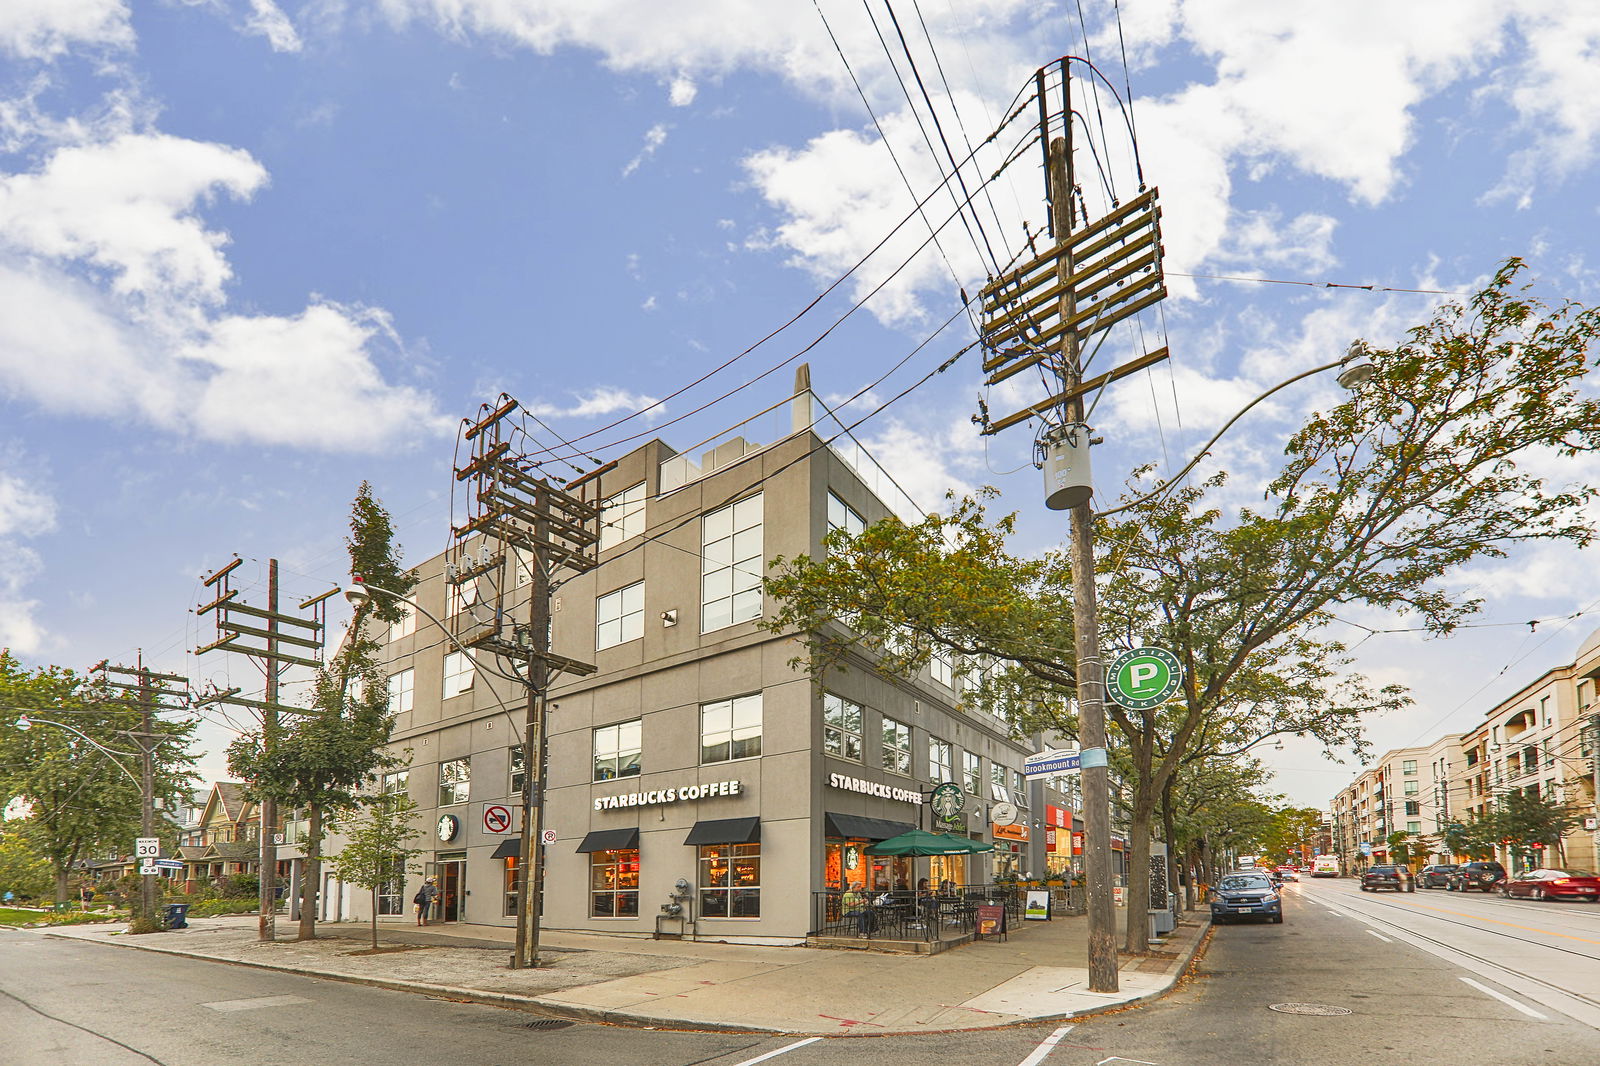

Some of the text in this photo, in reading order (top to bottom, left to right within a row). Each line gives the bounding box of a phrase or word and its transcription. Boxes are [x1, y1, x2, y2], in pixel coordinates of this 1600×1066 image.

[1110, 650, 1177, 680] MUNICIPAL
[1130, 663, 1158, 688] P
[1111, 680, 1177, 707] PARKING
[1025, 760, 1070, 774] Brookmount
[594, 780, 739, 811] STARBUCKS COFFEE
[830, 772, 923, 805] STARBUCKS COFFEE
[139, 846, 157, 855] 30
